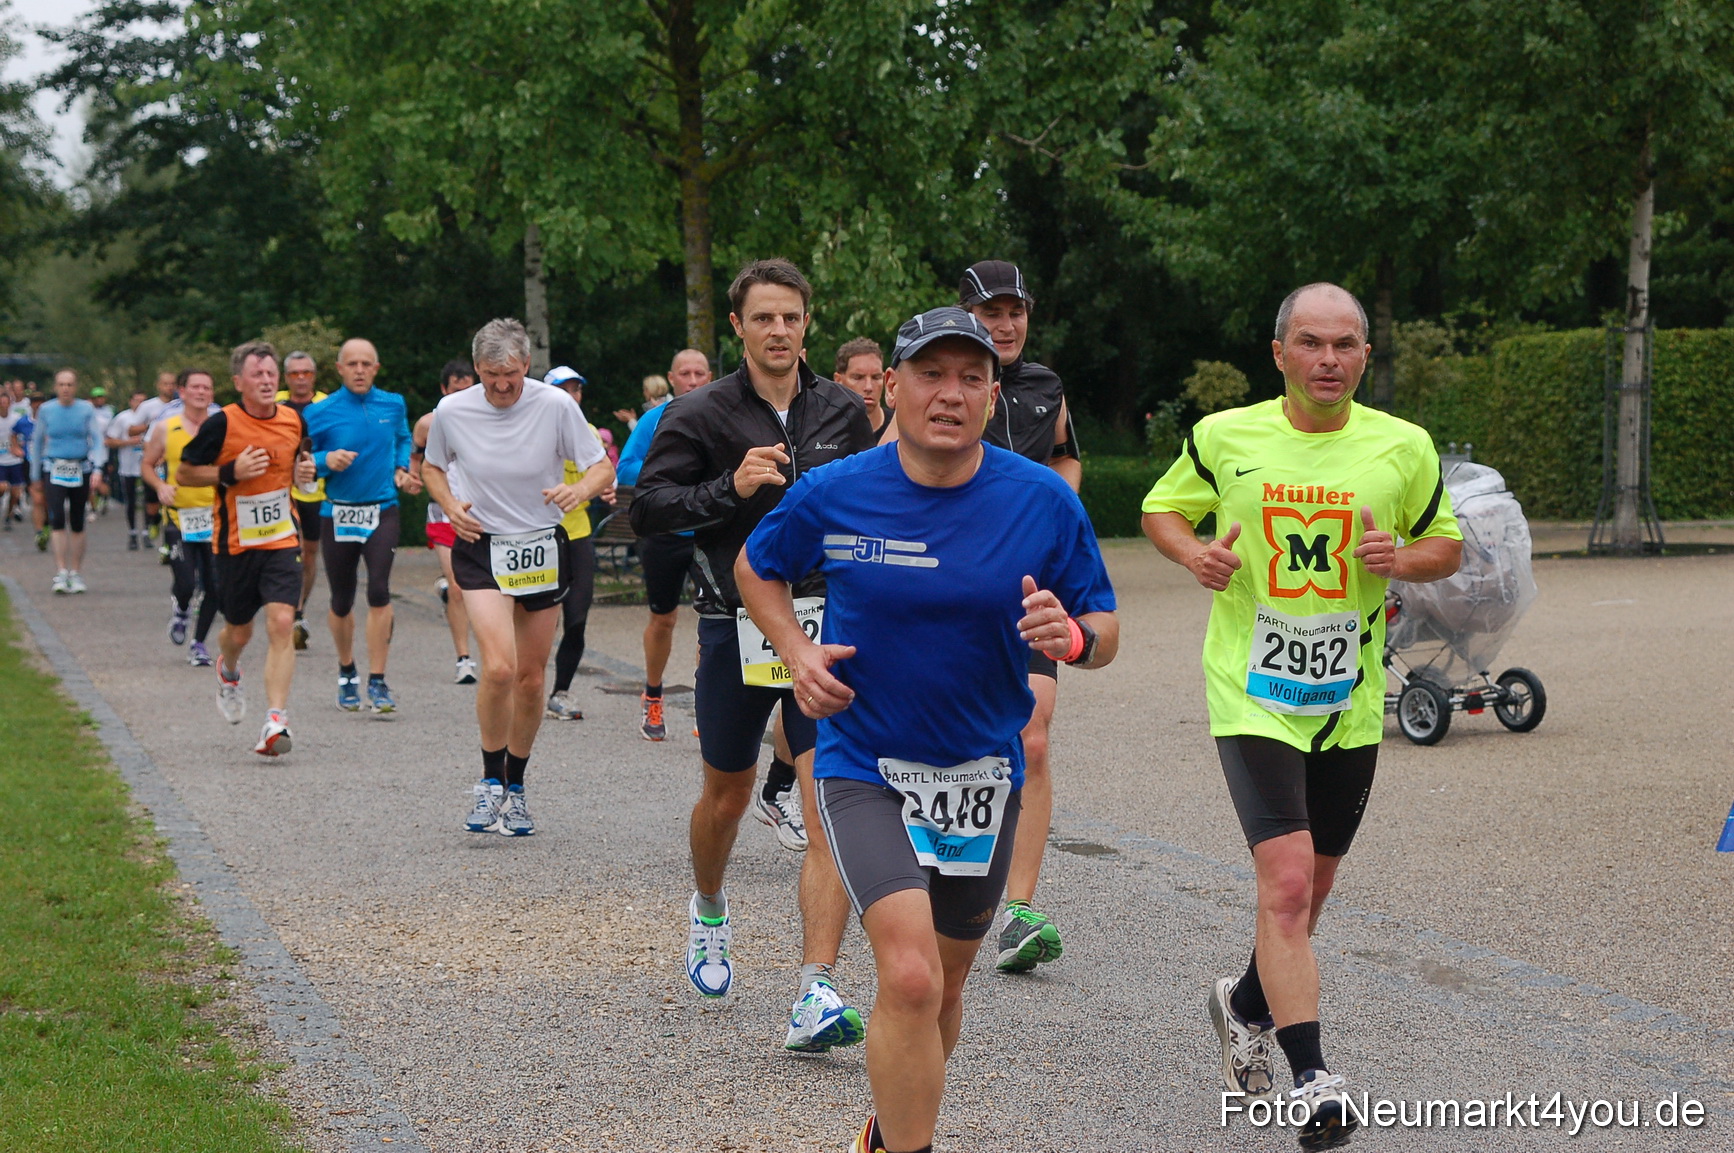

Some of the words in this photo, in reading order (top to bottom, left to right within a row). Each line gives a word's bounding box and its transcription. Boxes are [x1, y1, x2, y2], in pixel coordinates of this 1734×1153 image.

[1262, 482, 1355, 506] Müller
[250, 502, 281, 524] 165
[337, 509, 373, 526] 2204
[506, 545, 545, 571] 360
[1285, 533, 1332, 572] M
[508, 573, 545, 587] Bernhard
[1257, 613, 1291, 633] PARTL
[1293, 623, 1341, 637] Neumarkt
[762, 619, 819, 657] 42
[1260, 632, 1348, 680] 2952
[1269, 681, 1336, 705] Wolfgang
[886, 772, 930, 783] PARTL
[933, 769, 990, 783] Neumarkt
